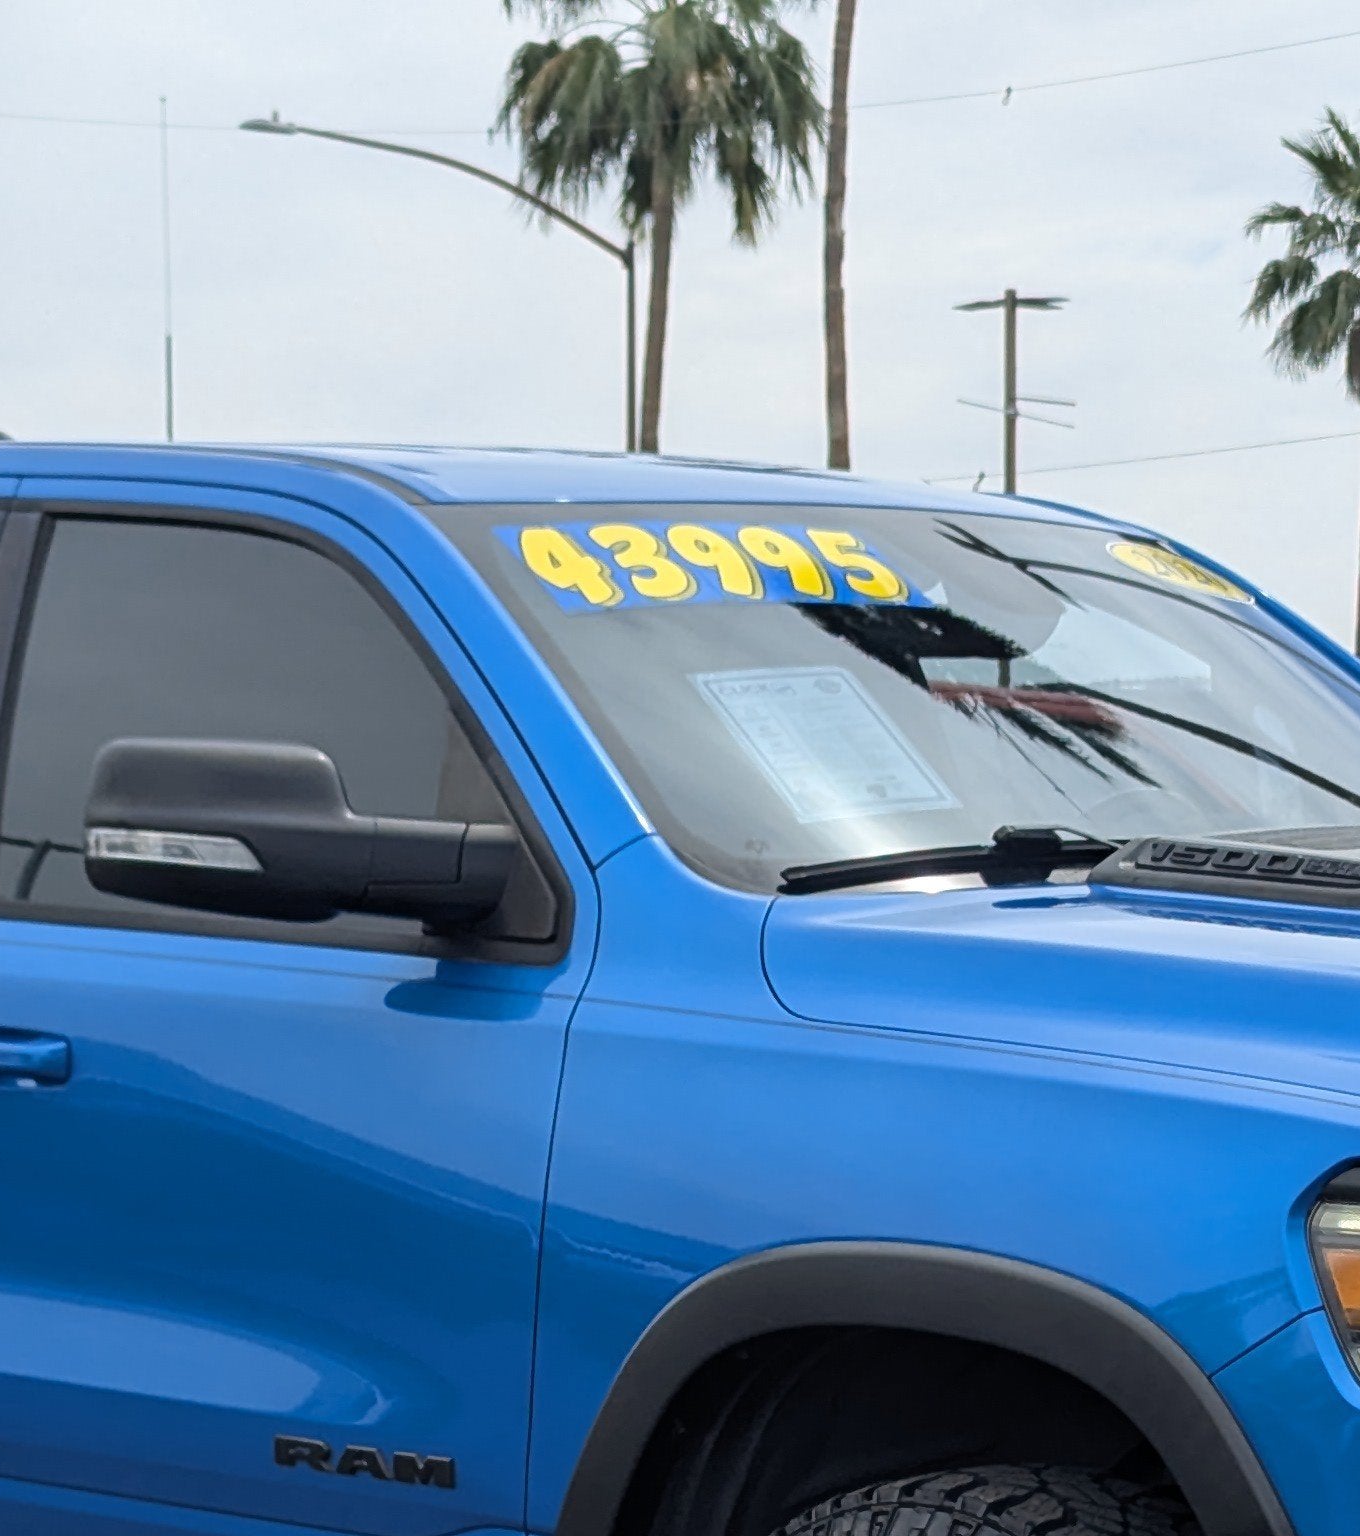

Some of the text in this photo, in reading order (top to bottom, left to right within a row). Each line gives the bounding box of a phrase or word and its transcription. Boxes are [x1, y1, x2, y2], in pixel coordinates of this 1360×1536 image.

[520, 524, 908, 606] 43995
[1150, 840, 1304, 874] 1500
[273, 1432, 456, 1490] RAM
